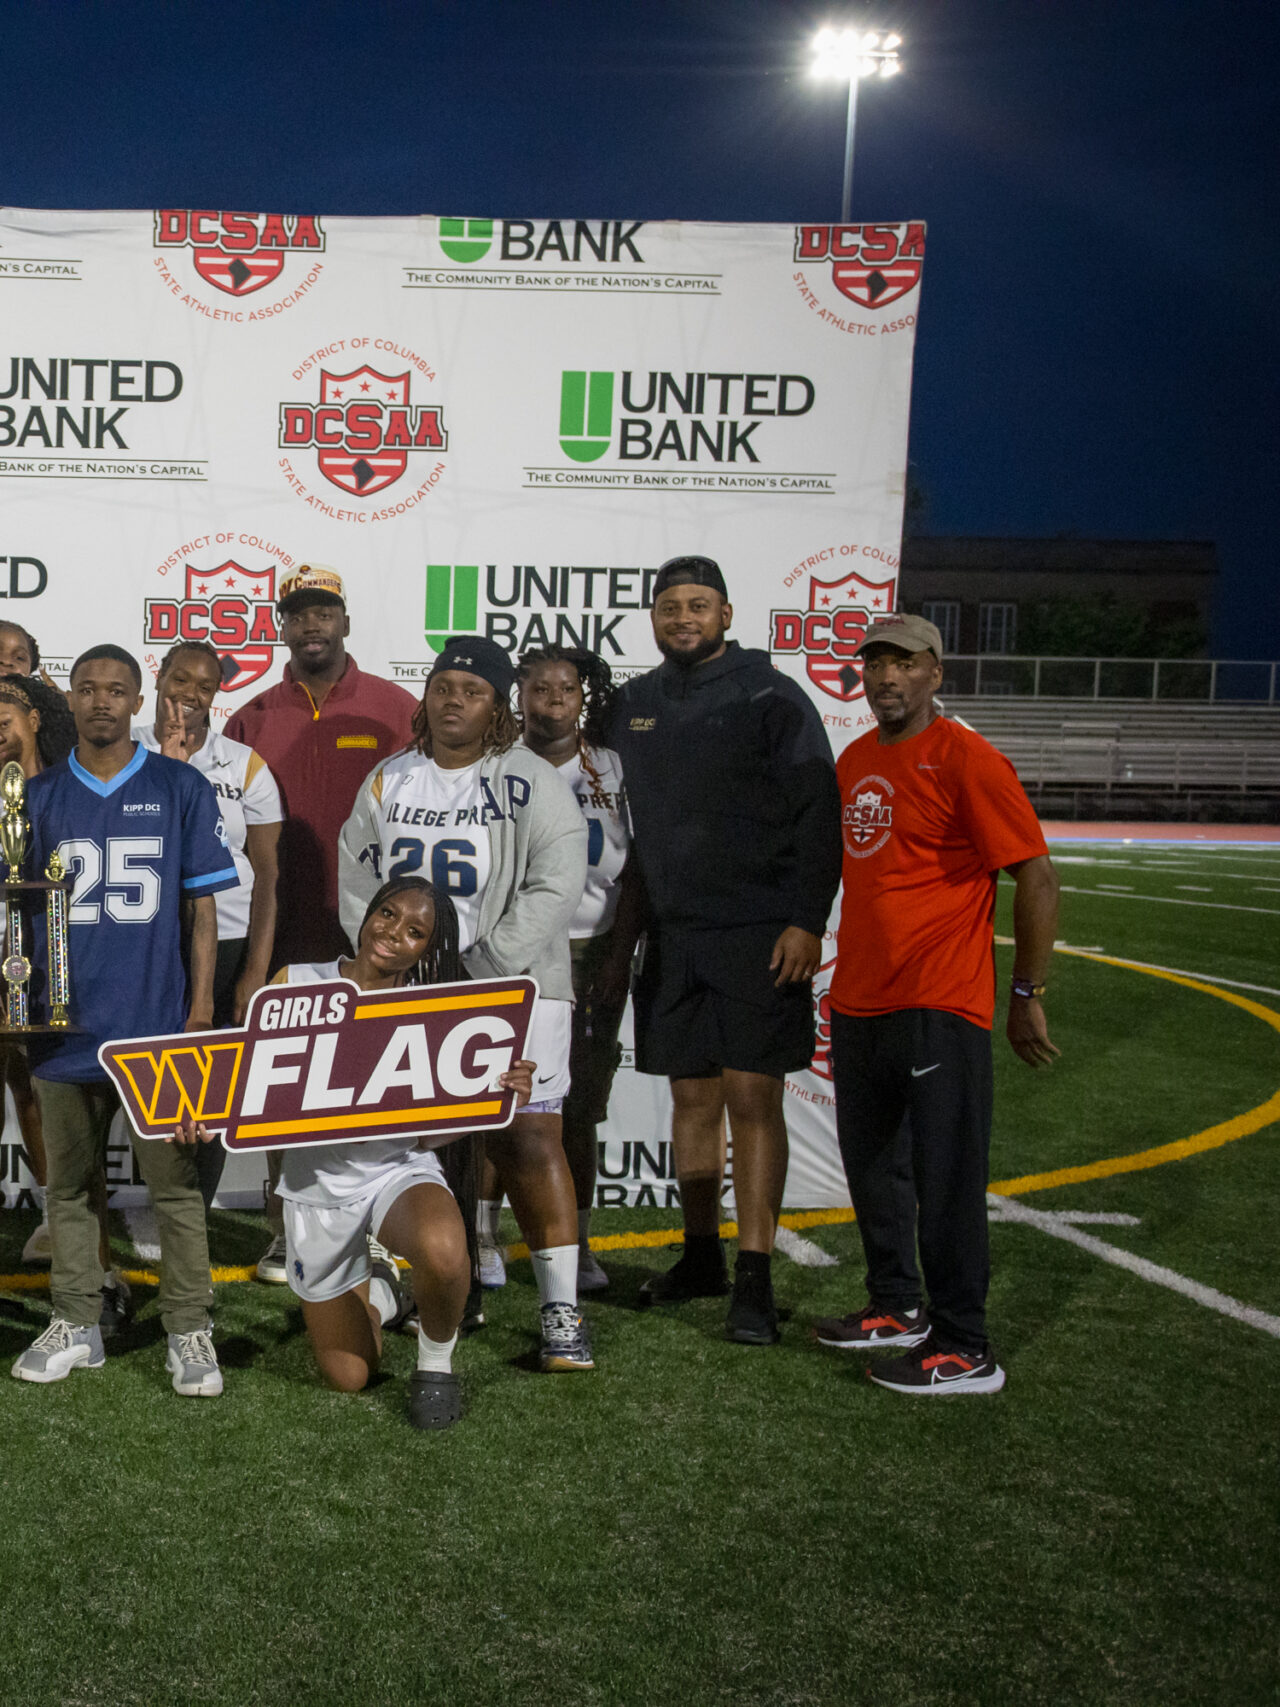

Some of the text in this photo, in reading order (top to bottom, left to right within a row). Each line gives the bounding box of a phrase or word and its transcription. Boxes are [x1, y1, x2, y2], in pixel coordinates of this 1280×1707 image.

[153, 210, 326, 254] DCSAA
[500, 220, 647, 263] BANK
[793, 224, 925, 266] DCSA
[154, 257, 323, 322] STATE ATHLETIC ASSOCIATION
[793, 272, 819, 310] STATE
[817, 308, 876, 335] ATHLETIC
[291, 337, 437, 382] DISTRICT OF COLUMBIA
[621, 371, 815, 417] UNITED
[278, 399, 448, 455] DCSAA
[618, 418, 762, 463] BANK
[278, 458, 447, 523] STATE ATHLETIC ASSOCIATION
[157, 532, 296, 576] DISTRICT OF COLUMBI
[783, 548, 836, 588] DISTRICT
[840, 545, 858, 556] OF
[144, 594, 284, 649] DCSA
[123, 804, 143, 812] KIPP
[454, 806, 489, 827] PRE
[843, 803, 892, 827] DCSAA
[57, 836, 163, 925] 25
[389, 837, 478, 897] 26
[259, 991, 349, 1031] GIRLS
[240, 1015, 516, 1117] FLAG
